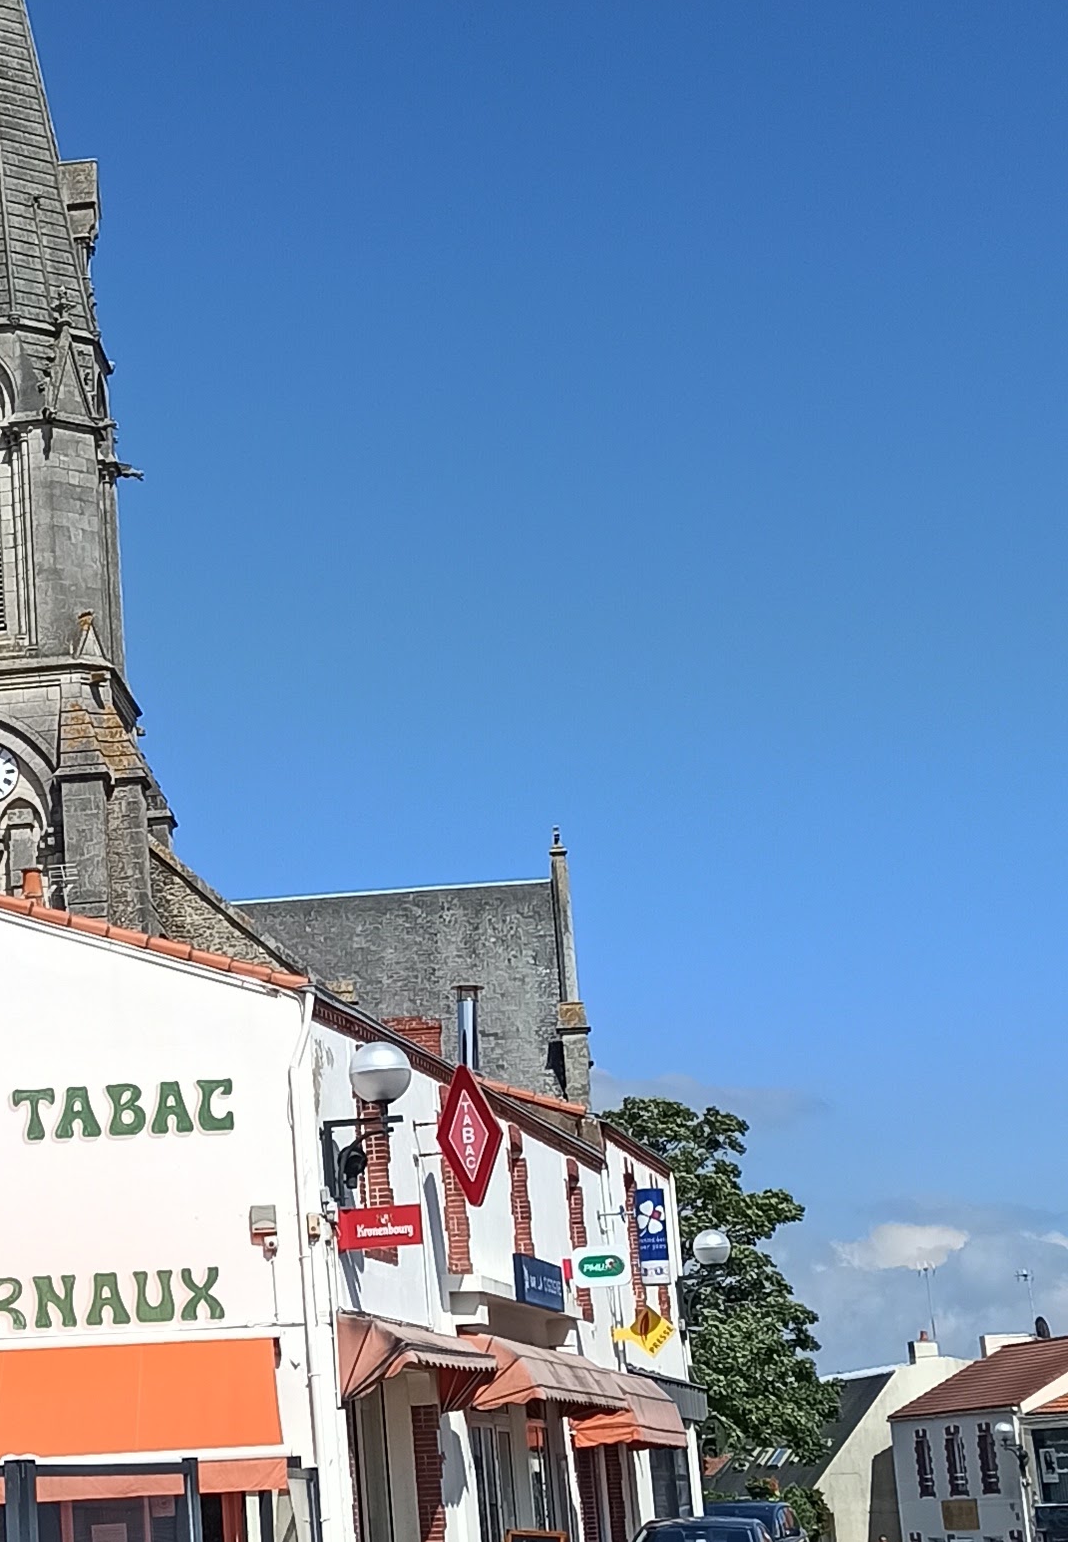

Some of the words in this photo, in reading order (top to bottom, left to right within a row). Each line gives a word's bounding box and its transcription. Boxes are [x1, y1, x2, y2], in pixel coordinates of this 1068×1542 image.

[11, 1077, 235, 1142] TABAC
[461, 1101, 477, 1169] TABAC
[356, 1222, 414, 1238] Kronenbourg
[583, 1263, 605, 1273] PMU
[649, 1325, 674, 1354] PRESSE
